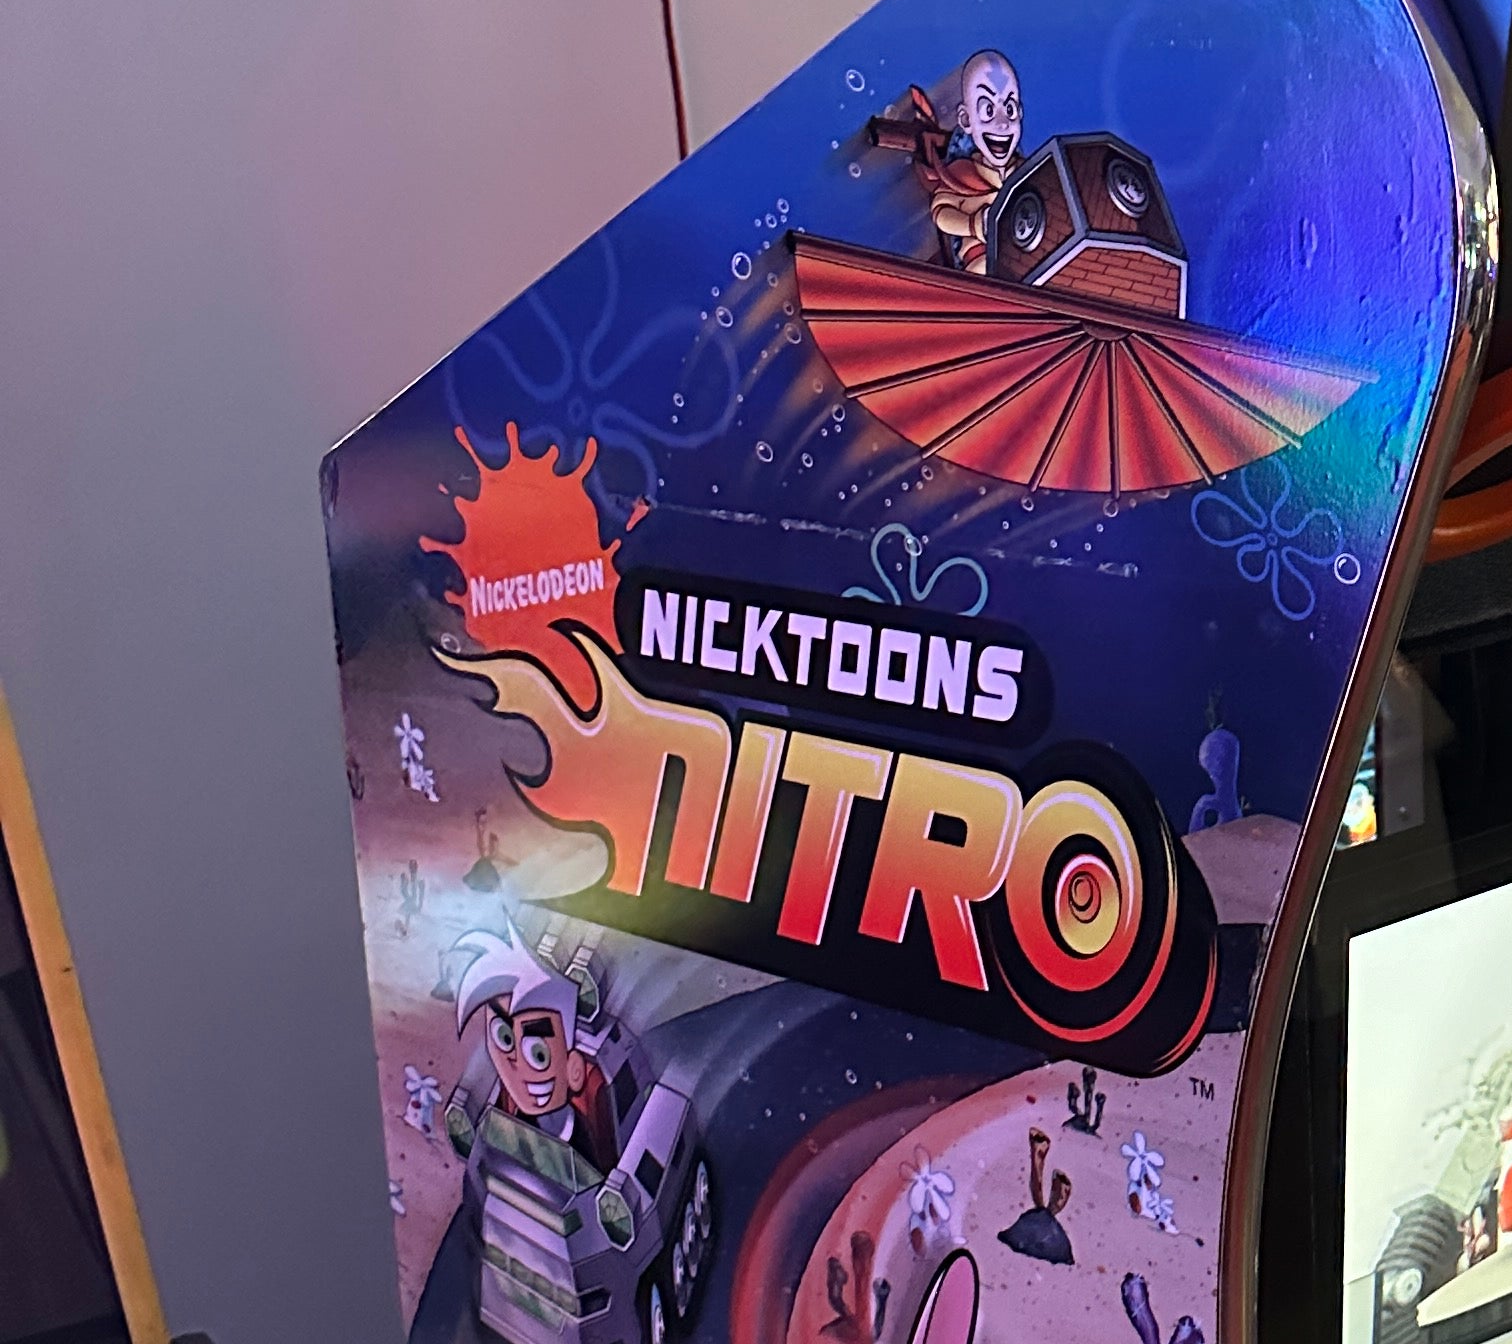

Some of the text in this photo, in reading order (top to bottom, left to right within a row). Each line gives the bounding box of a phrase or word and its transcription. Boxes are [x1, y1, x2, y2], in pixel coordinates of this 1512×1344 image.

[470, 557, 604, 618] NICKELODEON
[640, 588, 1025, 723] NICKTOONS
[1188, 1076, 1215, 1102] TM
